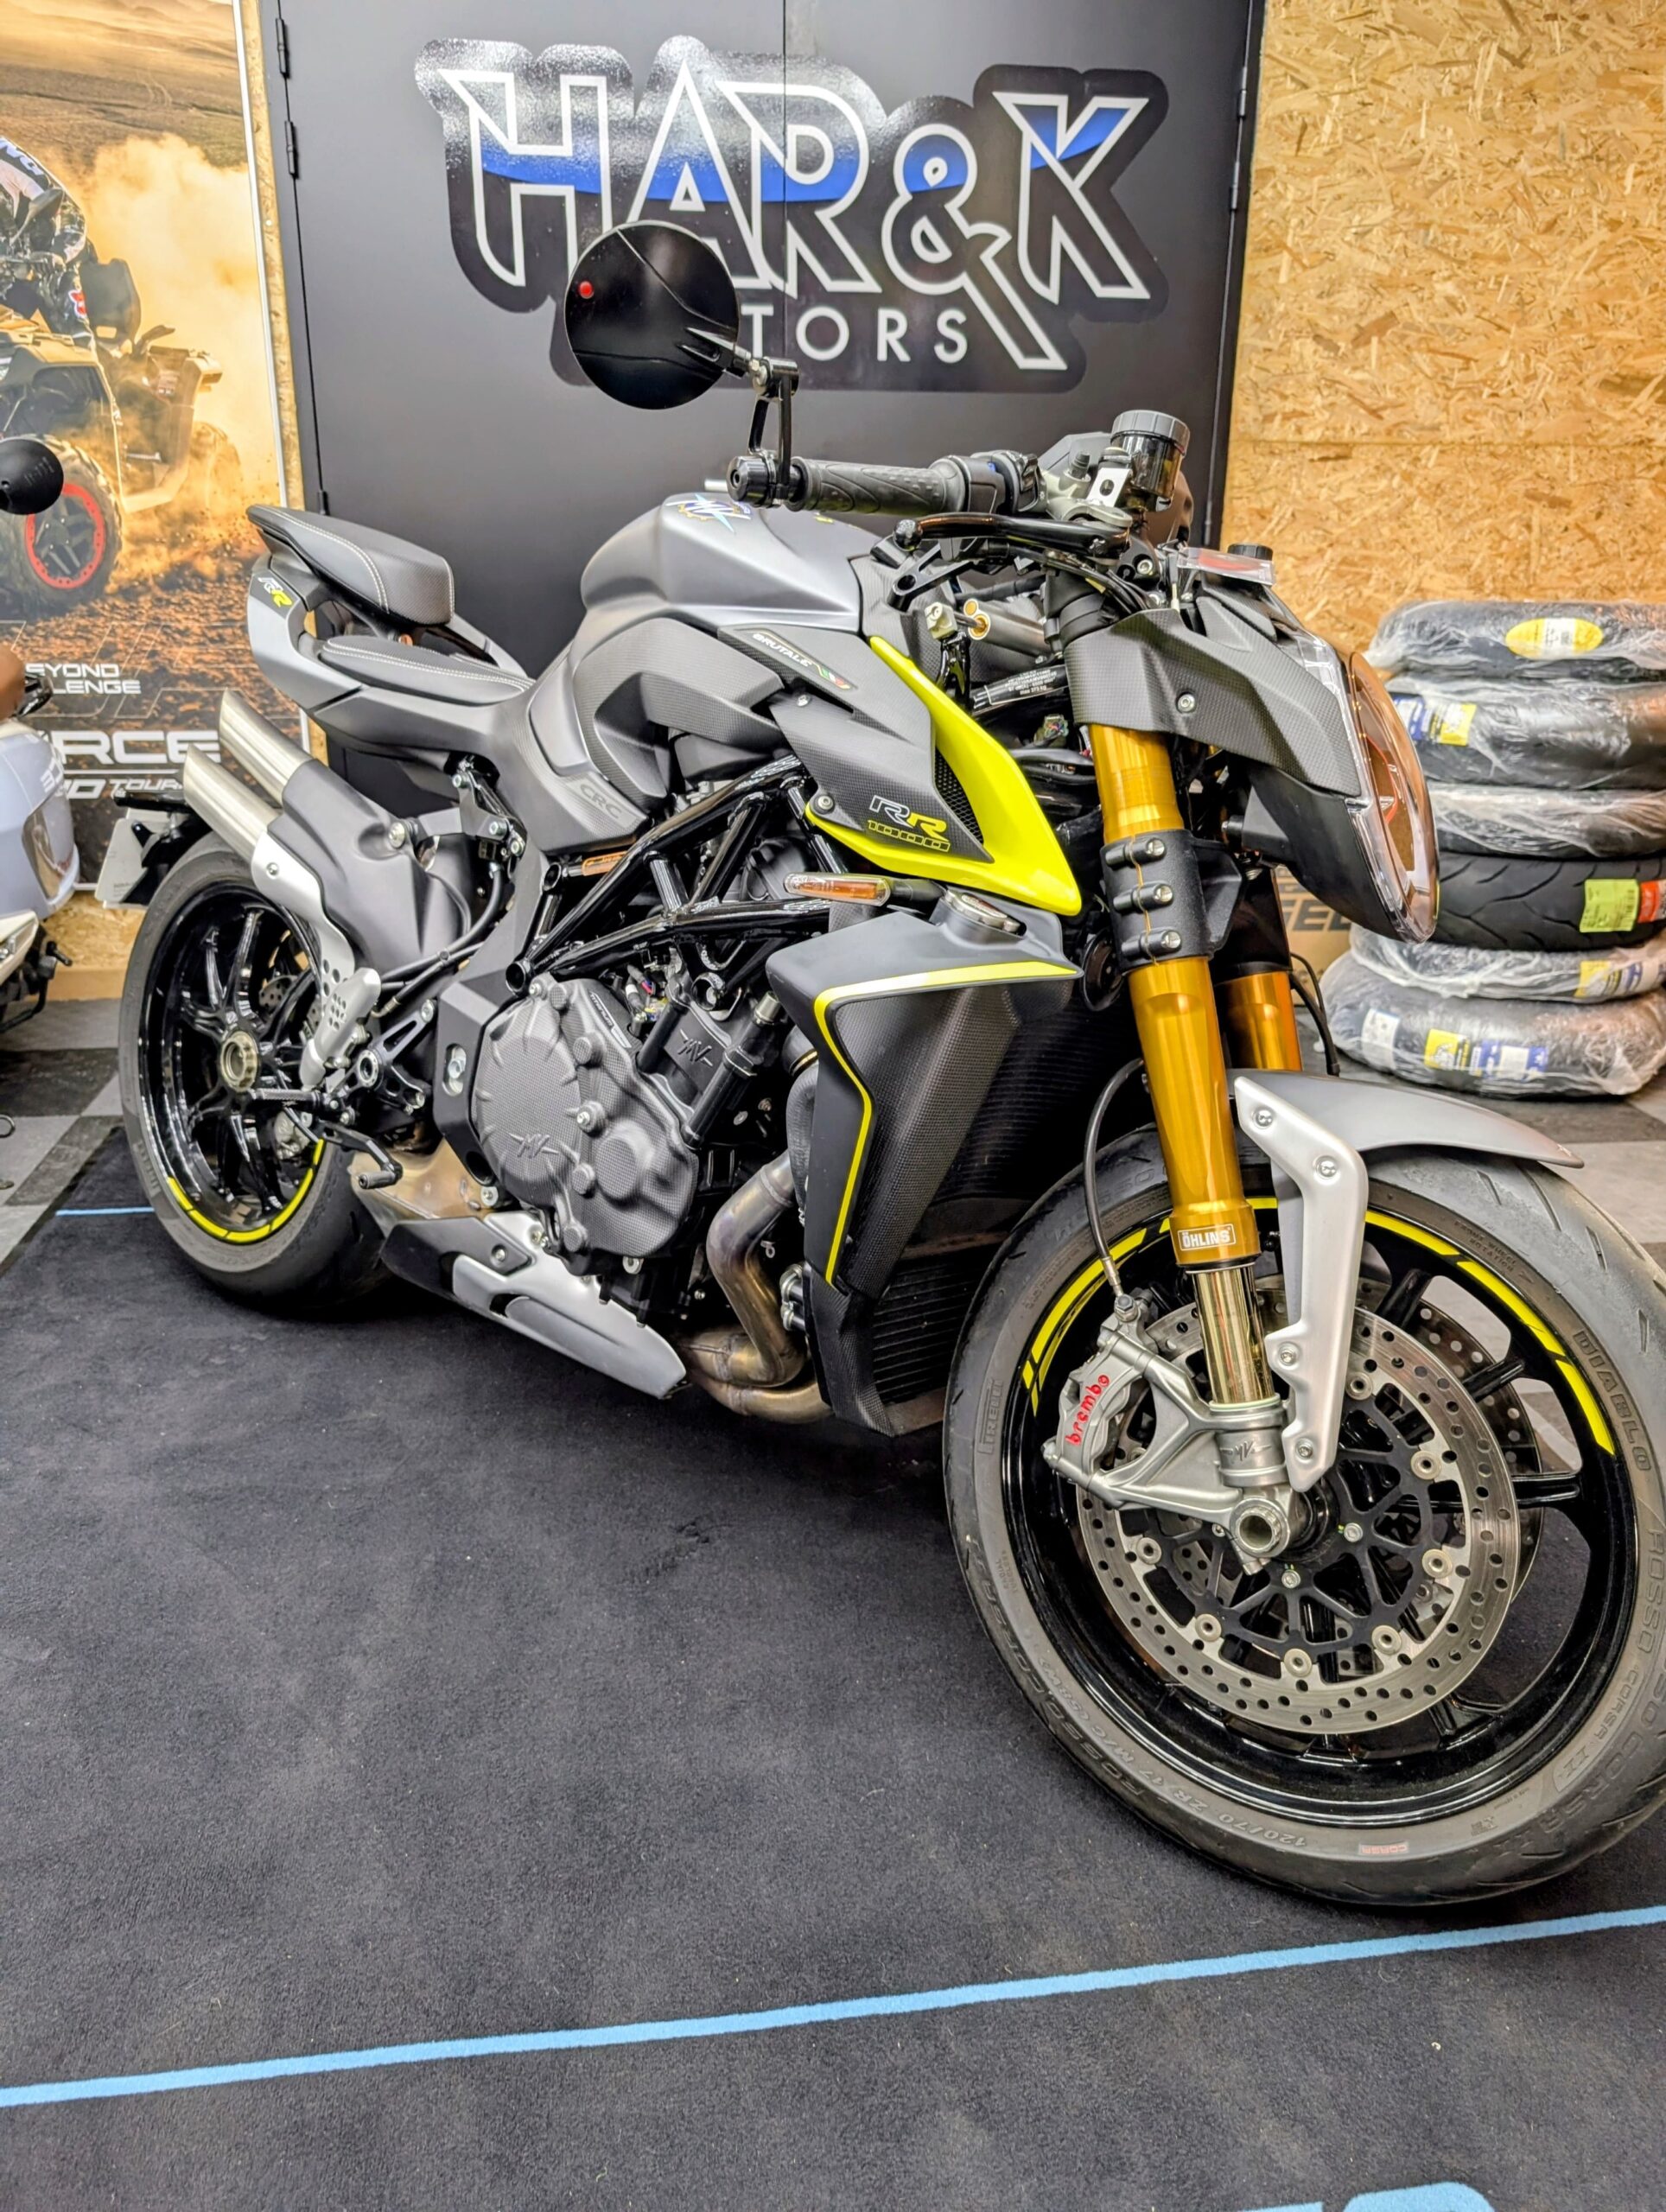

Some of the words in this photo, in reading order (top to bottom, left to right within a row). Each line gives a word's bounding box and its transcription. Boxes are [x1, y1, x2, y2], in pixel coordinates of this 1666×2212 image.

[741, 306, 969, 362] TORS
[753, 633, 812, 667] BRUTALE
[25, 663, 120, 677] EYOND
[51, 730, 221, 764] RCE
[580, 784, 622, 819] CRC
[869, 795, 950, 842] RR
[868, 819, 951, 852] 1000
[1181, 1230, 1230, 1249] ÖHLINS
[1065, 1375, 1110, 1446] brembo
[1573, 1331, 1651, 1471] DIABLO
[1637, 1529, 1665, 1654] ROSSO
[1594, 1669, 1639, 1739] CORSA
[1092, 1726, 1135, 1765] M/C
[1140, 1768, 1164, 1787] 17
[1171, 1789, 1209, 1813] ZR
[1218, 1812, 1308, 1847] 120/70
